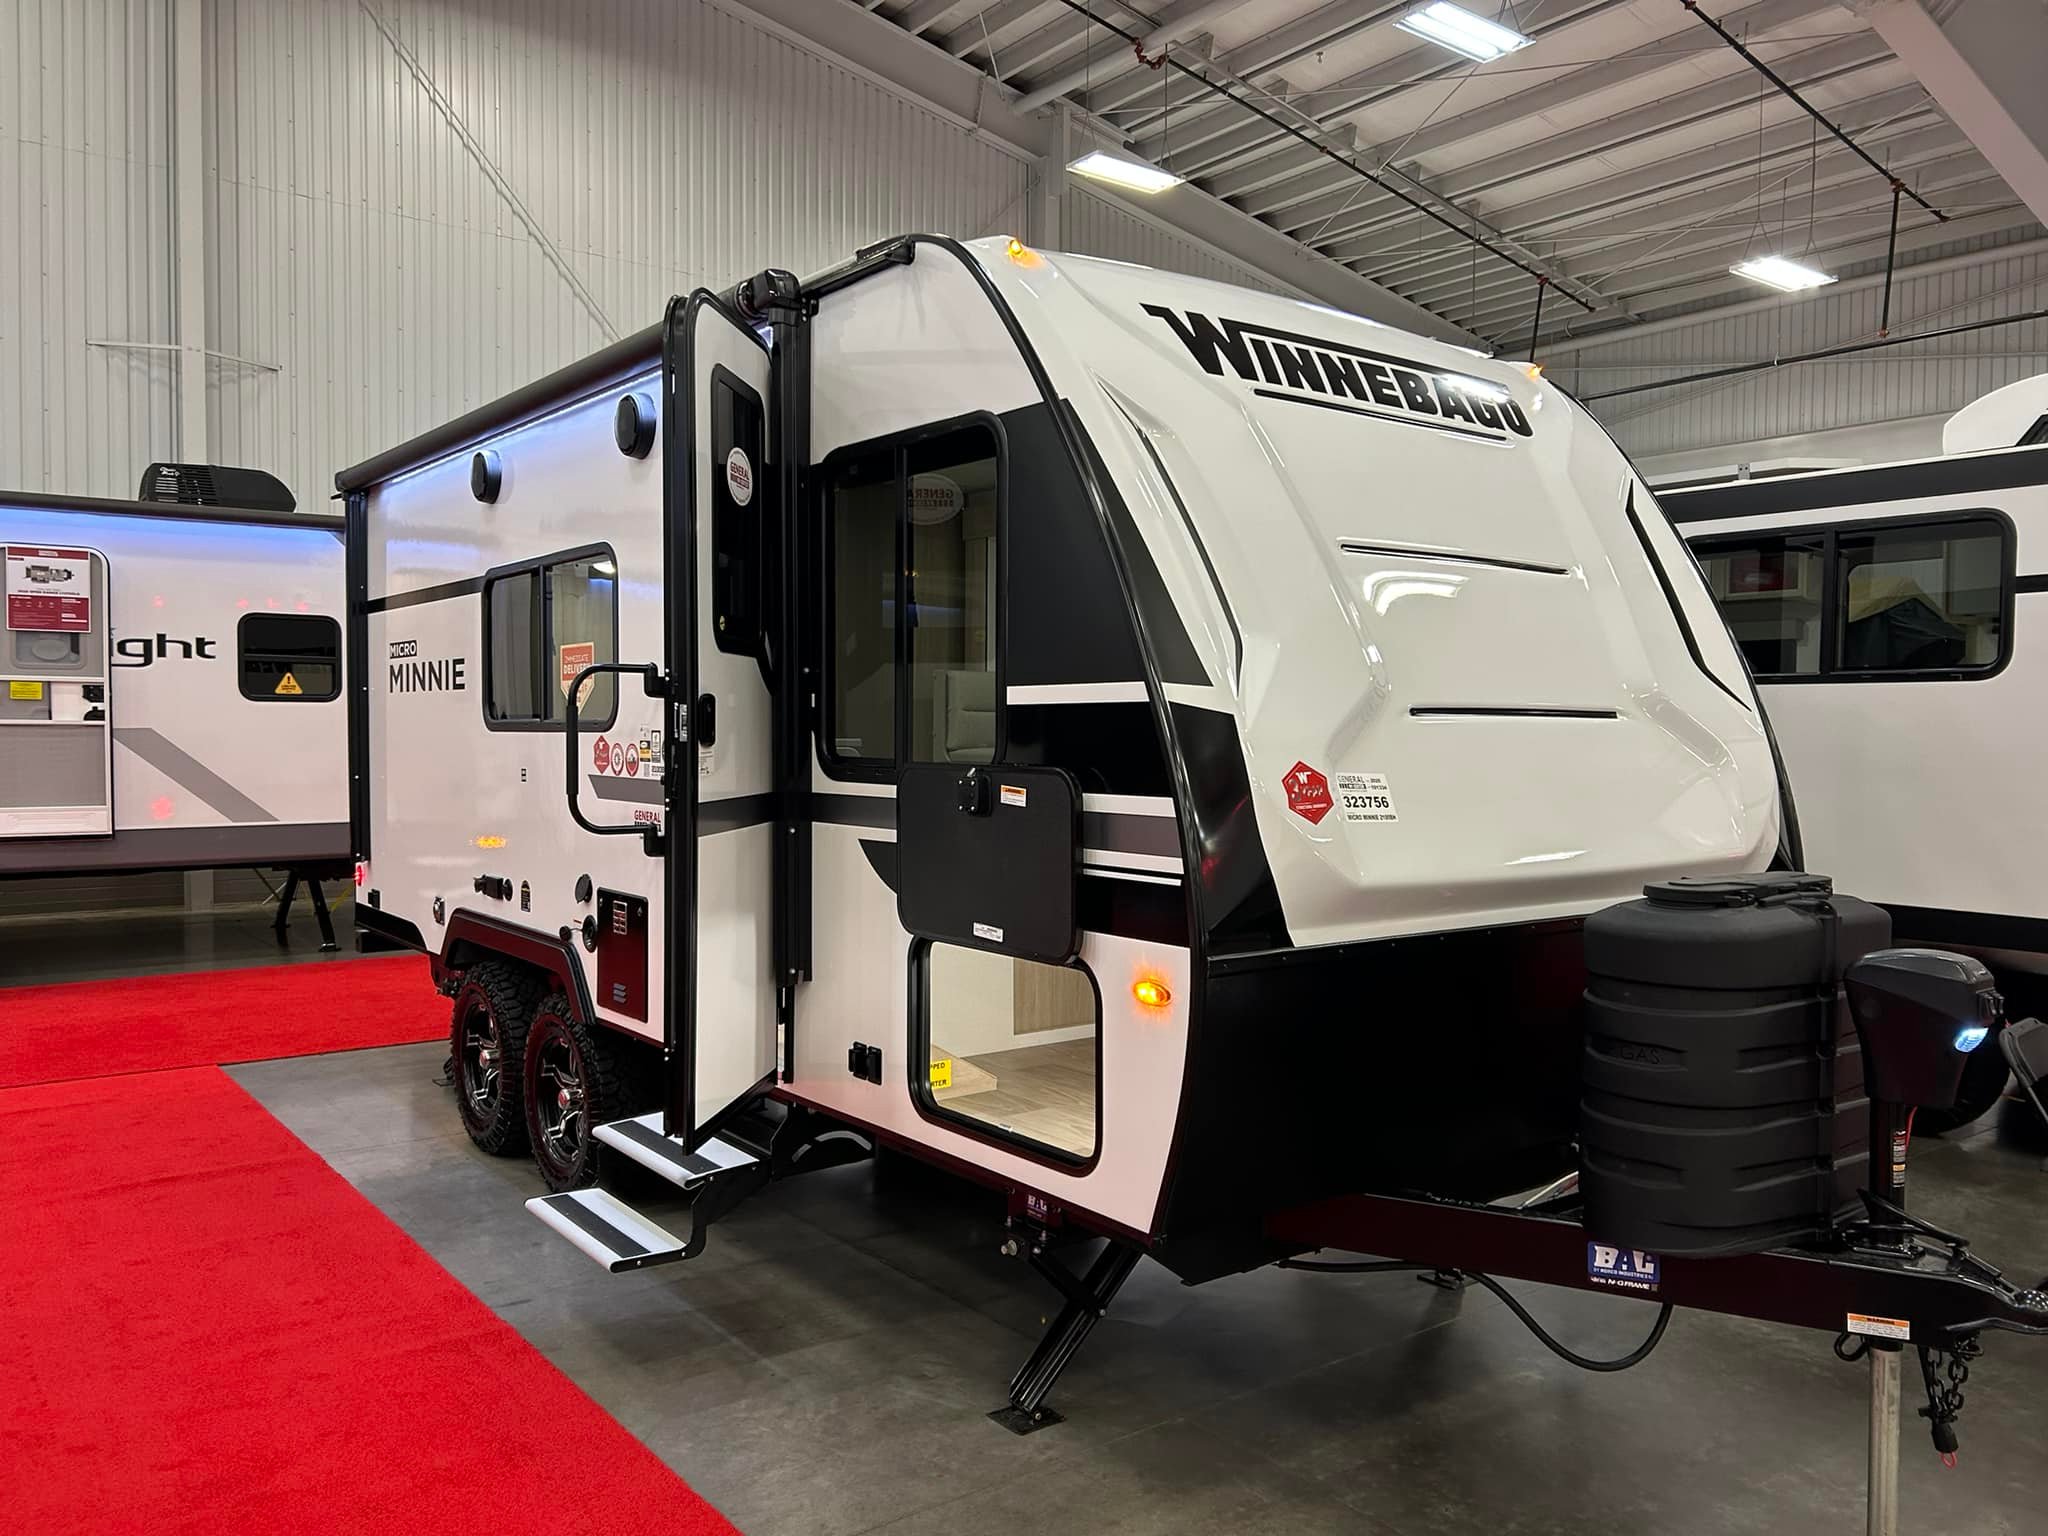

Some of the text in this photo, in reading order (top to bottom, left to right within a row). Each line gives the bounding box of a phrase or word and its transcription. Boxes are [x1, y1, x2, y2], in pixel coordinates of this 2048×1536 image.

[1140, 303, 1534, 437] WINNEBAGO
[390, 641, 417, 658] MICRO
[389, 658, 465, 693] MINNIE
[1343, 796, 1389, 808] 323756
[634, 810, 661, 823] GENERAL
